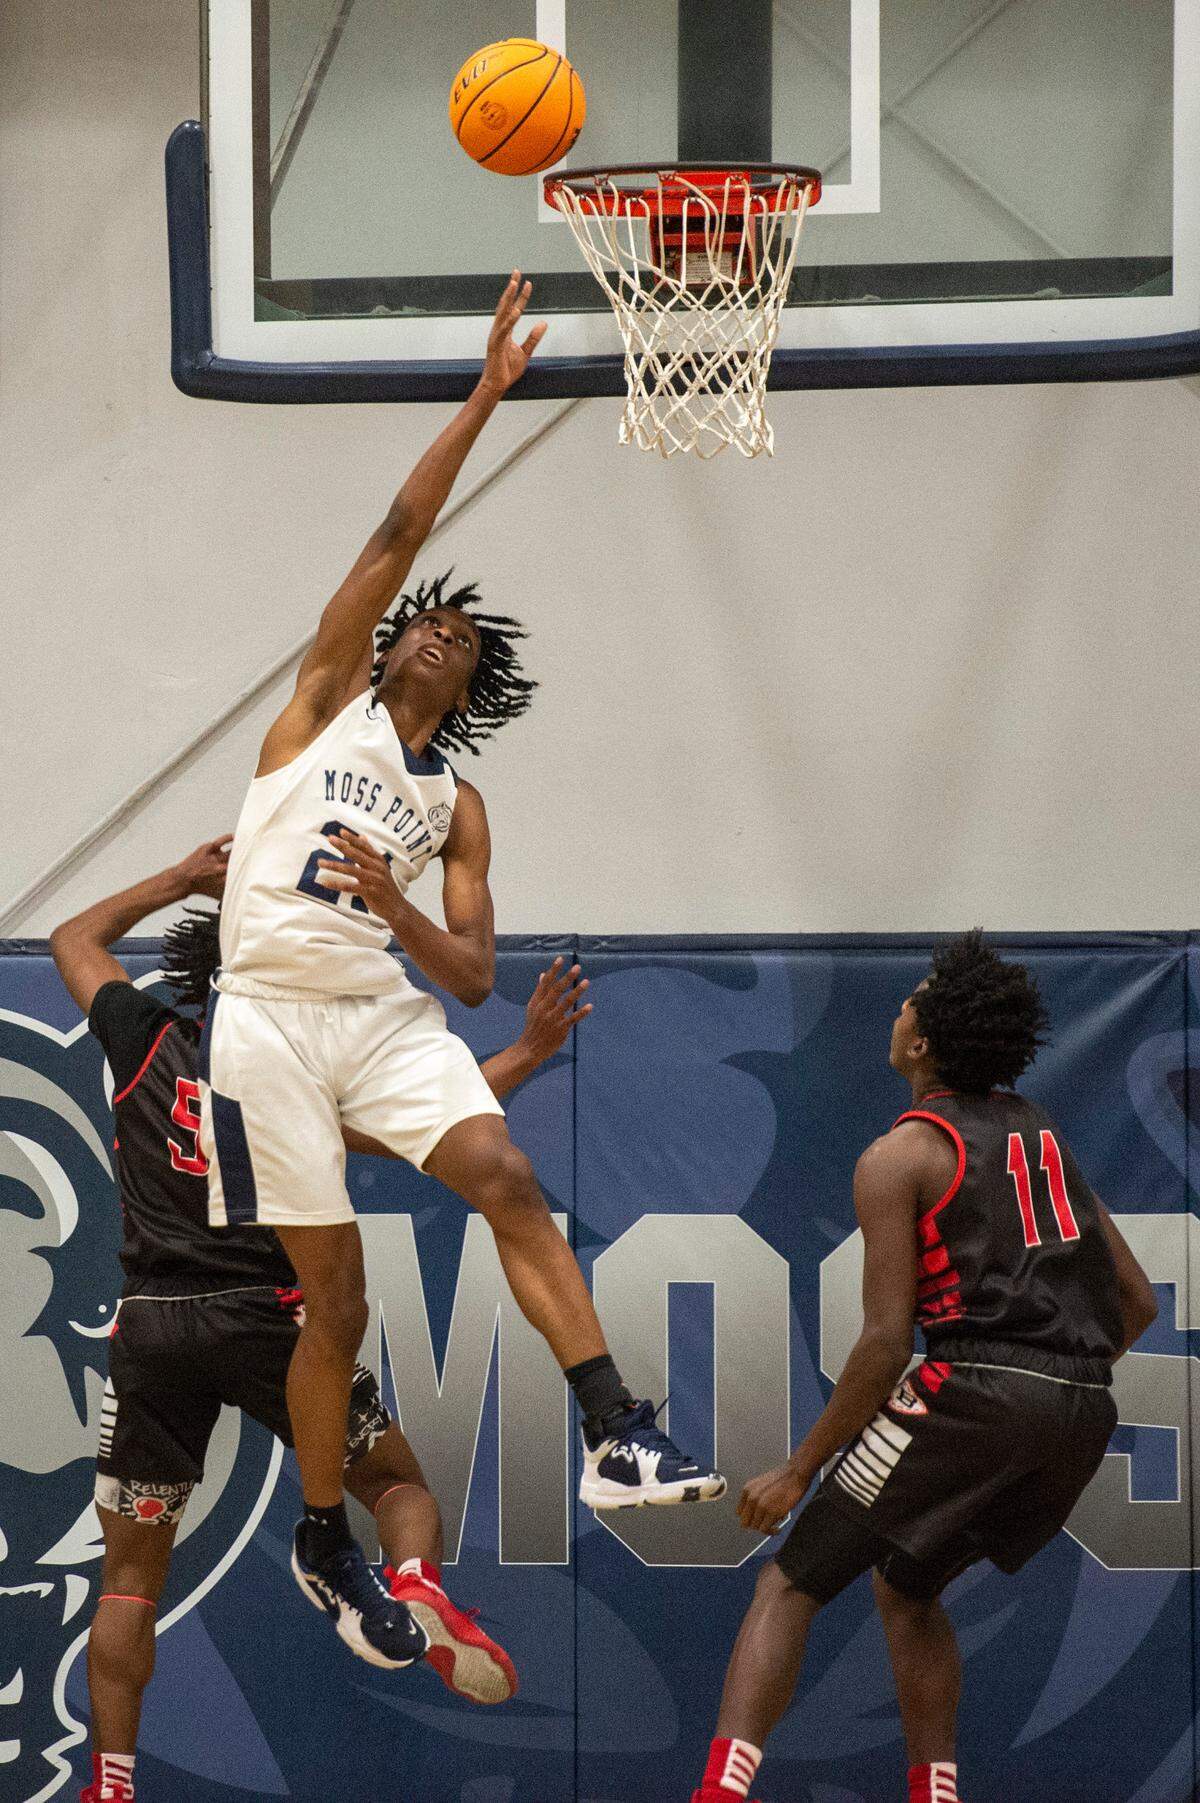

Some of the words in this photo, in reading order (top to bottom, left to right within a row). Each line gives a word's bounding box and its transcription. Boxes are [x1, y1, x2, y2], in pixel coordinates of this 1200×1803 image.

[323, 769, 383, 813] MOSS
[381, 795, 434, 863] POINT
[296, 820, 394, 914] 2
[167, 1076, 210, 1176] 5
[1006, 1129, 1081, 1248] 11
